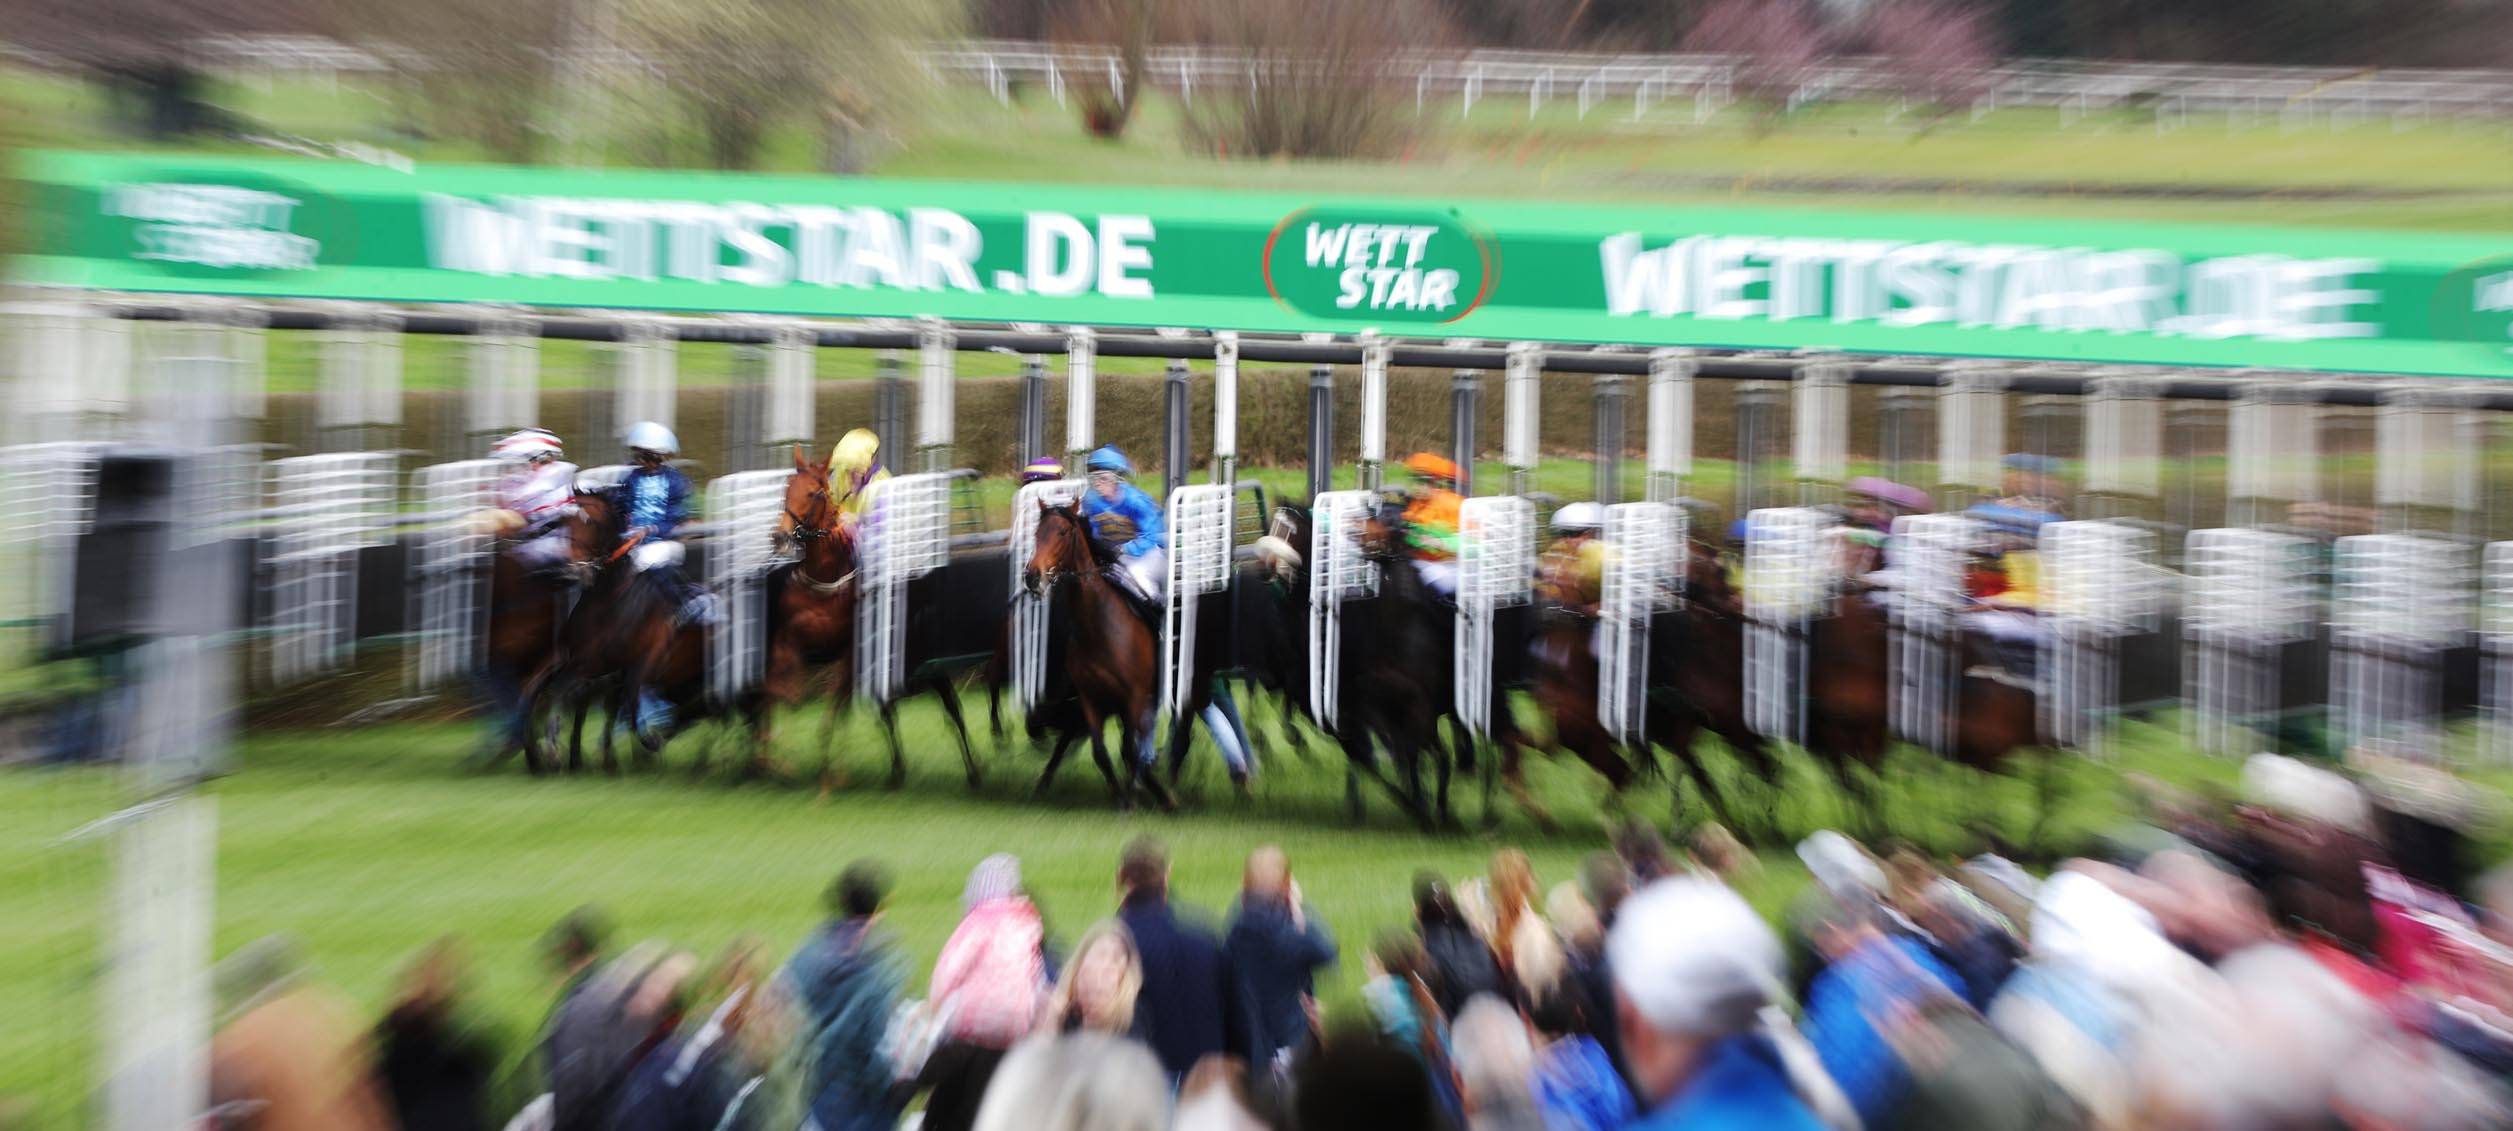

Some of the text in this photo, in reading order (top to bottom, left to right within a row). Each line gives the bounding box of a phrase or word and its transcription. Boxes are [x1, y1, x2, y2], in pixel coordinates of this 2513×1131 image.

[422, 192, 1155, 297] WETTSTAR.DE
[1305, 221, 1440, 268] WETT
[1335, 266, 1461, 312] STAR
